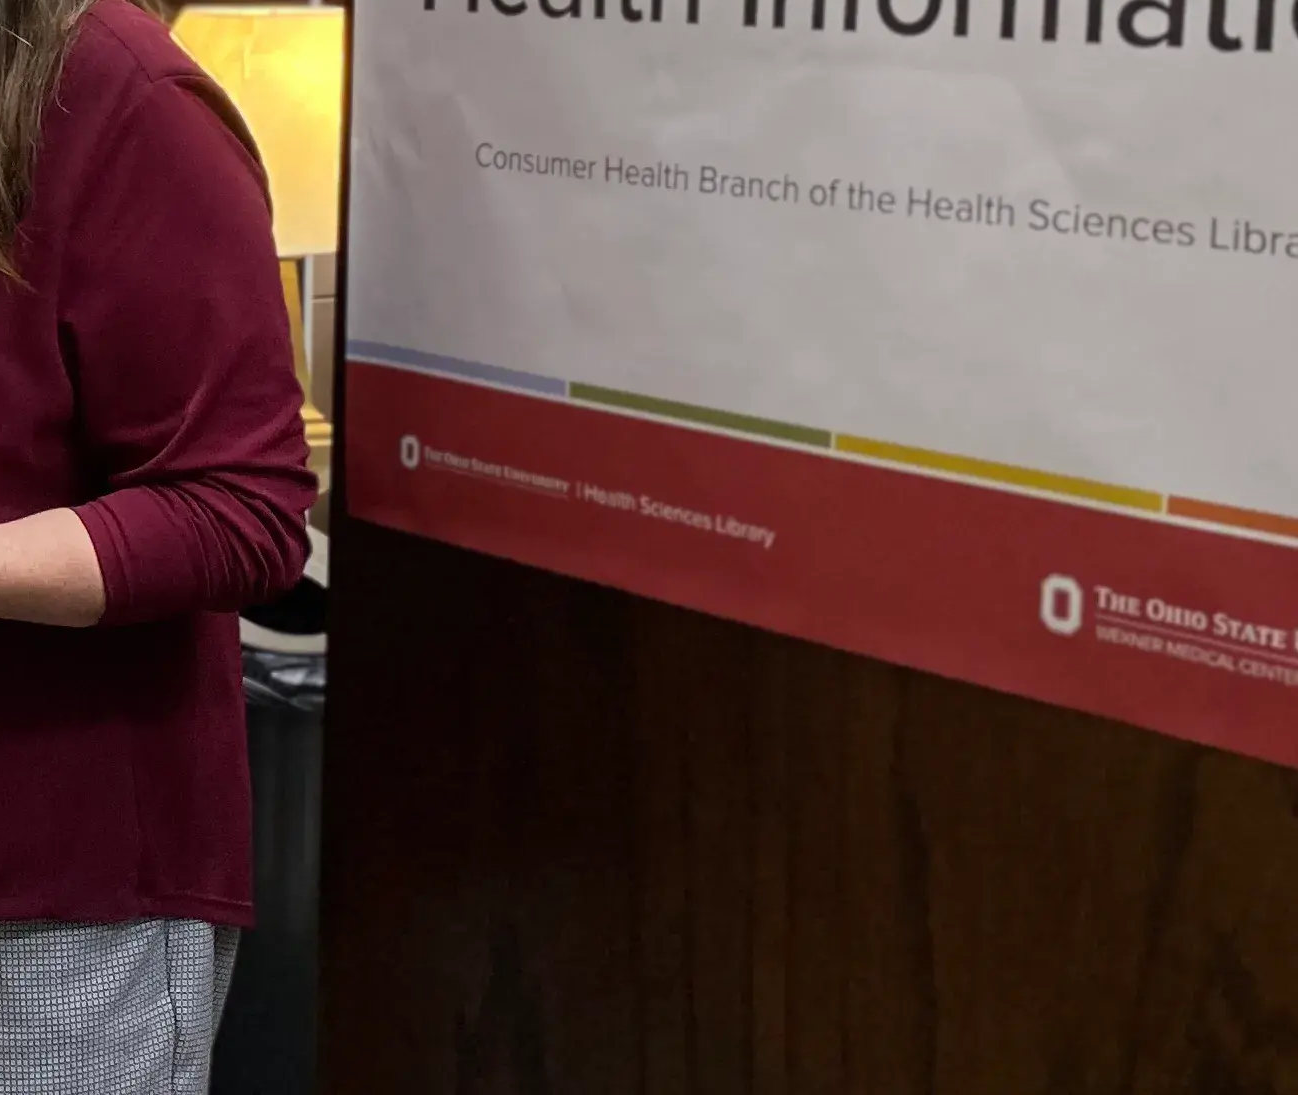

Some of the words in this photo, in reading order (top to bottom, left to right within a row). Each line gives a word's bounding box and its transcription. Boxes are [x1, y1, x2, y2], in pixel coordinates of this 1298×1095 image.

[475, 142, 597, 181] Consumer
[604, 155, 690, 192] Health
[698, 165, 800, 204] Branch
[808, 179, 842, 207] of
[847, 182, 896, 215] the
[907, 186, 1015, 228] Health
[1028, 198, 1196, 248] Sciences
[583, 481, 636, 512] Health
[639, 493, 713, 532] Sciences
[715, 512, 777, 550] Library
[1095, 624, 1164, 654] WEXNER
[1165, 641, 1236, 673] MEDICAL
[1212, 612, 1288, 650] STATE
